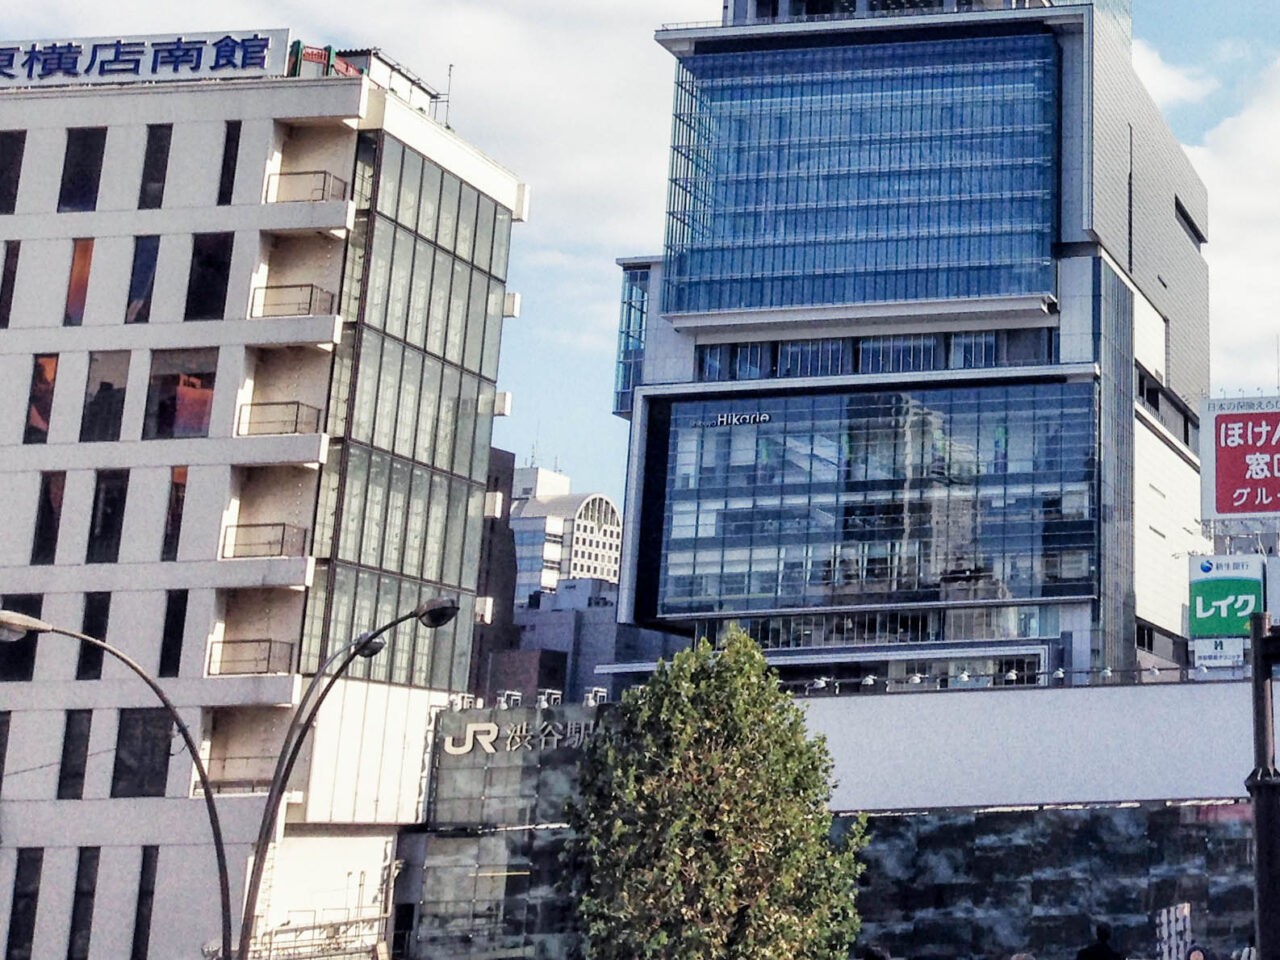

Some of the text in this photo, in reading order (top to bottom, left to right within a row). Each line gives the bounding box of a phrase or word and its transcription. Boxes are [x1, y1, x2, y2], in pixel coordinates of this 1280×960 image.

[717, 412, 770, 426] Hikarie
[1195, 594, 1256, 619] レイク
[443, 721, 595, 755] JR 渋谷駅
